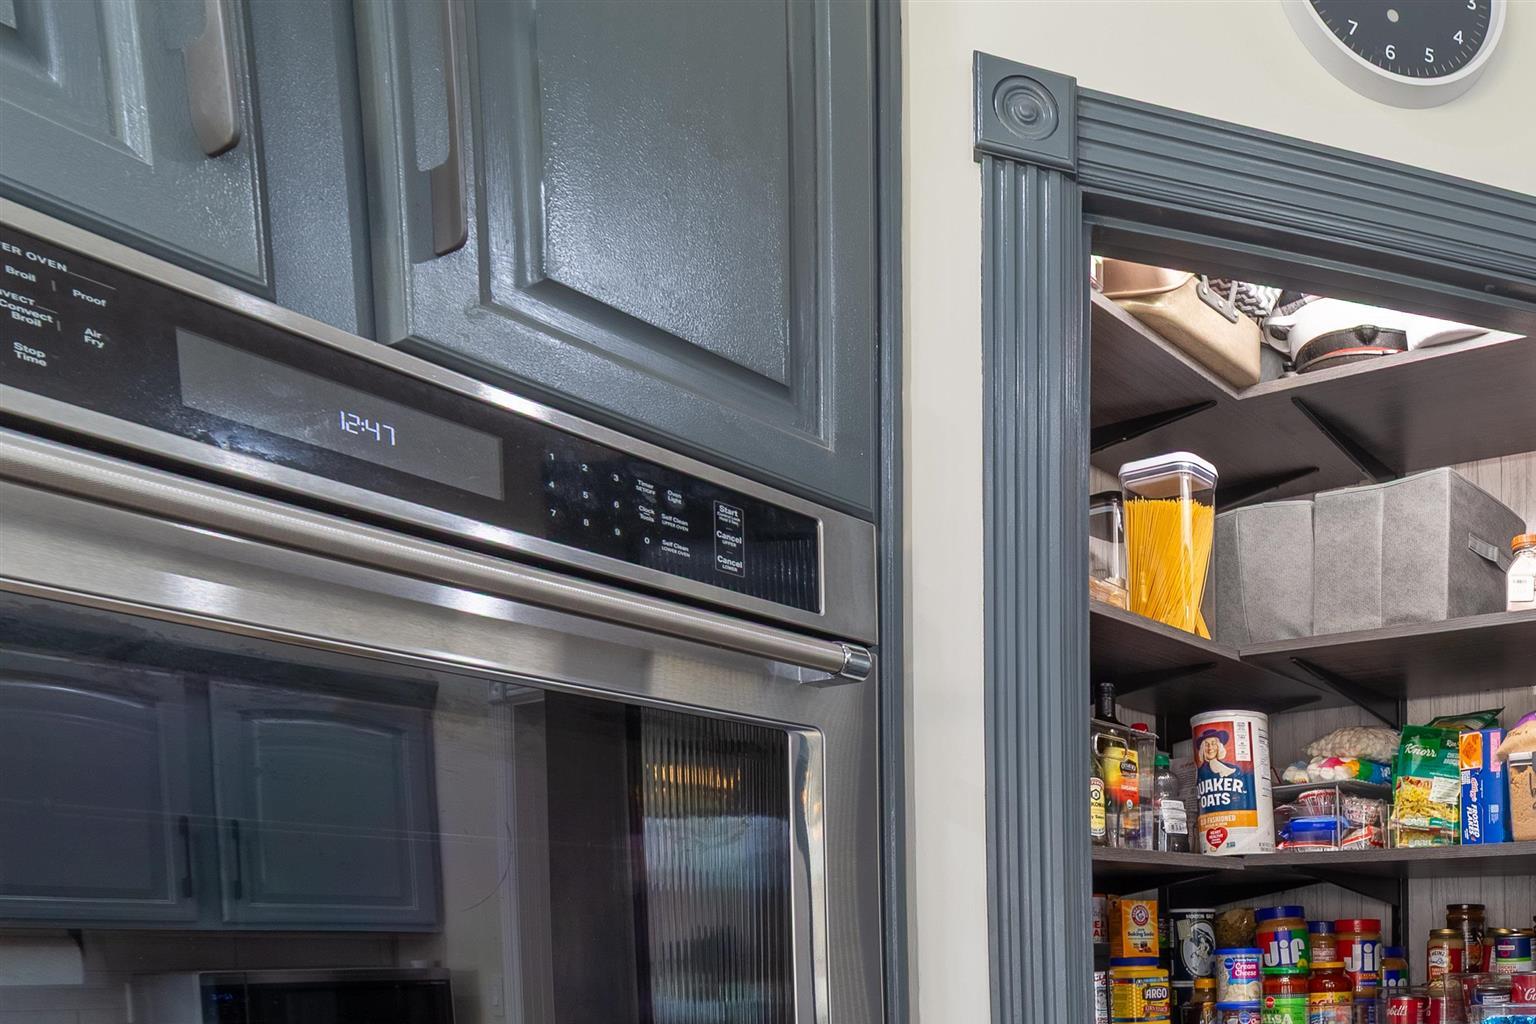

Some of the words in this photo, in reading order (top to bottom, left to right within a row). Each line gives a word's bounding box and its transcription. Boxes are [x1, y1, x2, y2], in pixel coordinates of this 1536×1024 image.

[1347, 19, 1358, 36] 7
[1452, 29, 1464, 45] 4
[1385, 44, 1396, 60] 6
[1424, 47, 1435, 63] 5
[25, 251, 68, 273] OVEN
[5, 264, 37, 282] Broil
[72, 288, 107, 307] Proof
[0, 298, 54, 324] Convect
[11, 310, 42, 328] Broil
[83, 334, 105, 349] Fry
[84, 327, 102, 340] Air
[13, 341, 46, 358] Stop
[13, 349, 48, 368] Time
[338, 410, 397, 446] 12:47
[549, 452, 555, 460] 1
[581, 463, 588, 472] 2
[612, 473, 619, 482] 3
[582, 490, 589, 499] 5
[550, 508, 557, 517] 7
[638, 504, 655, 515] Clock
[718, 504, 739, 518] Start
[672, 515, 689, 526] Clean
[644, 536, 650, 544] 0
[716, 529, 742, 545] Cancel
[673, 542, 689, 552] Clean
[717, 554, 743, 569] Cancel
[1404, 743, 1437, 758] Knorr
[1201, 791, 1231, 809] OATS
[1466, 806, 1476, 836] FLAKES
[1471, 803, 1480, 838] FROSTED
[1264, 938, 1305, 967] Jif
[1343, 942, 1381, 973] Jif
[1234, 962, 1257, 970] Cream
[1234, 969, 1257, 977] Cheese
[1144, 987, 1168, 999] ARGO
